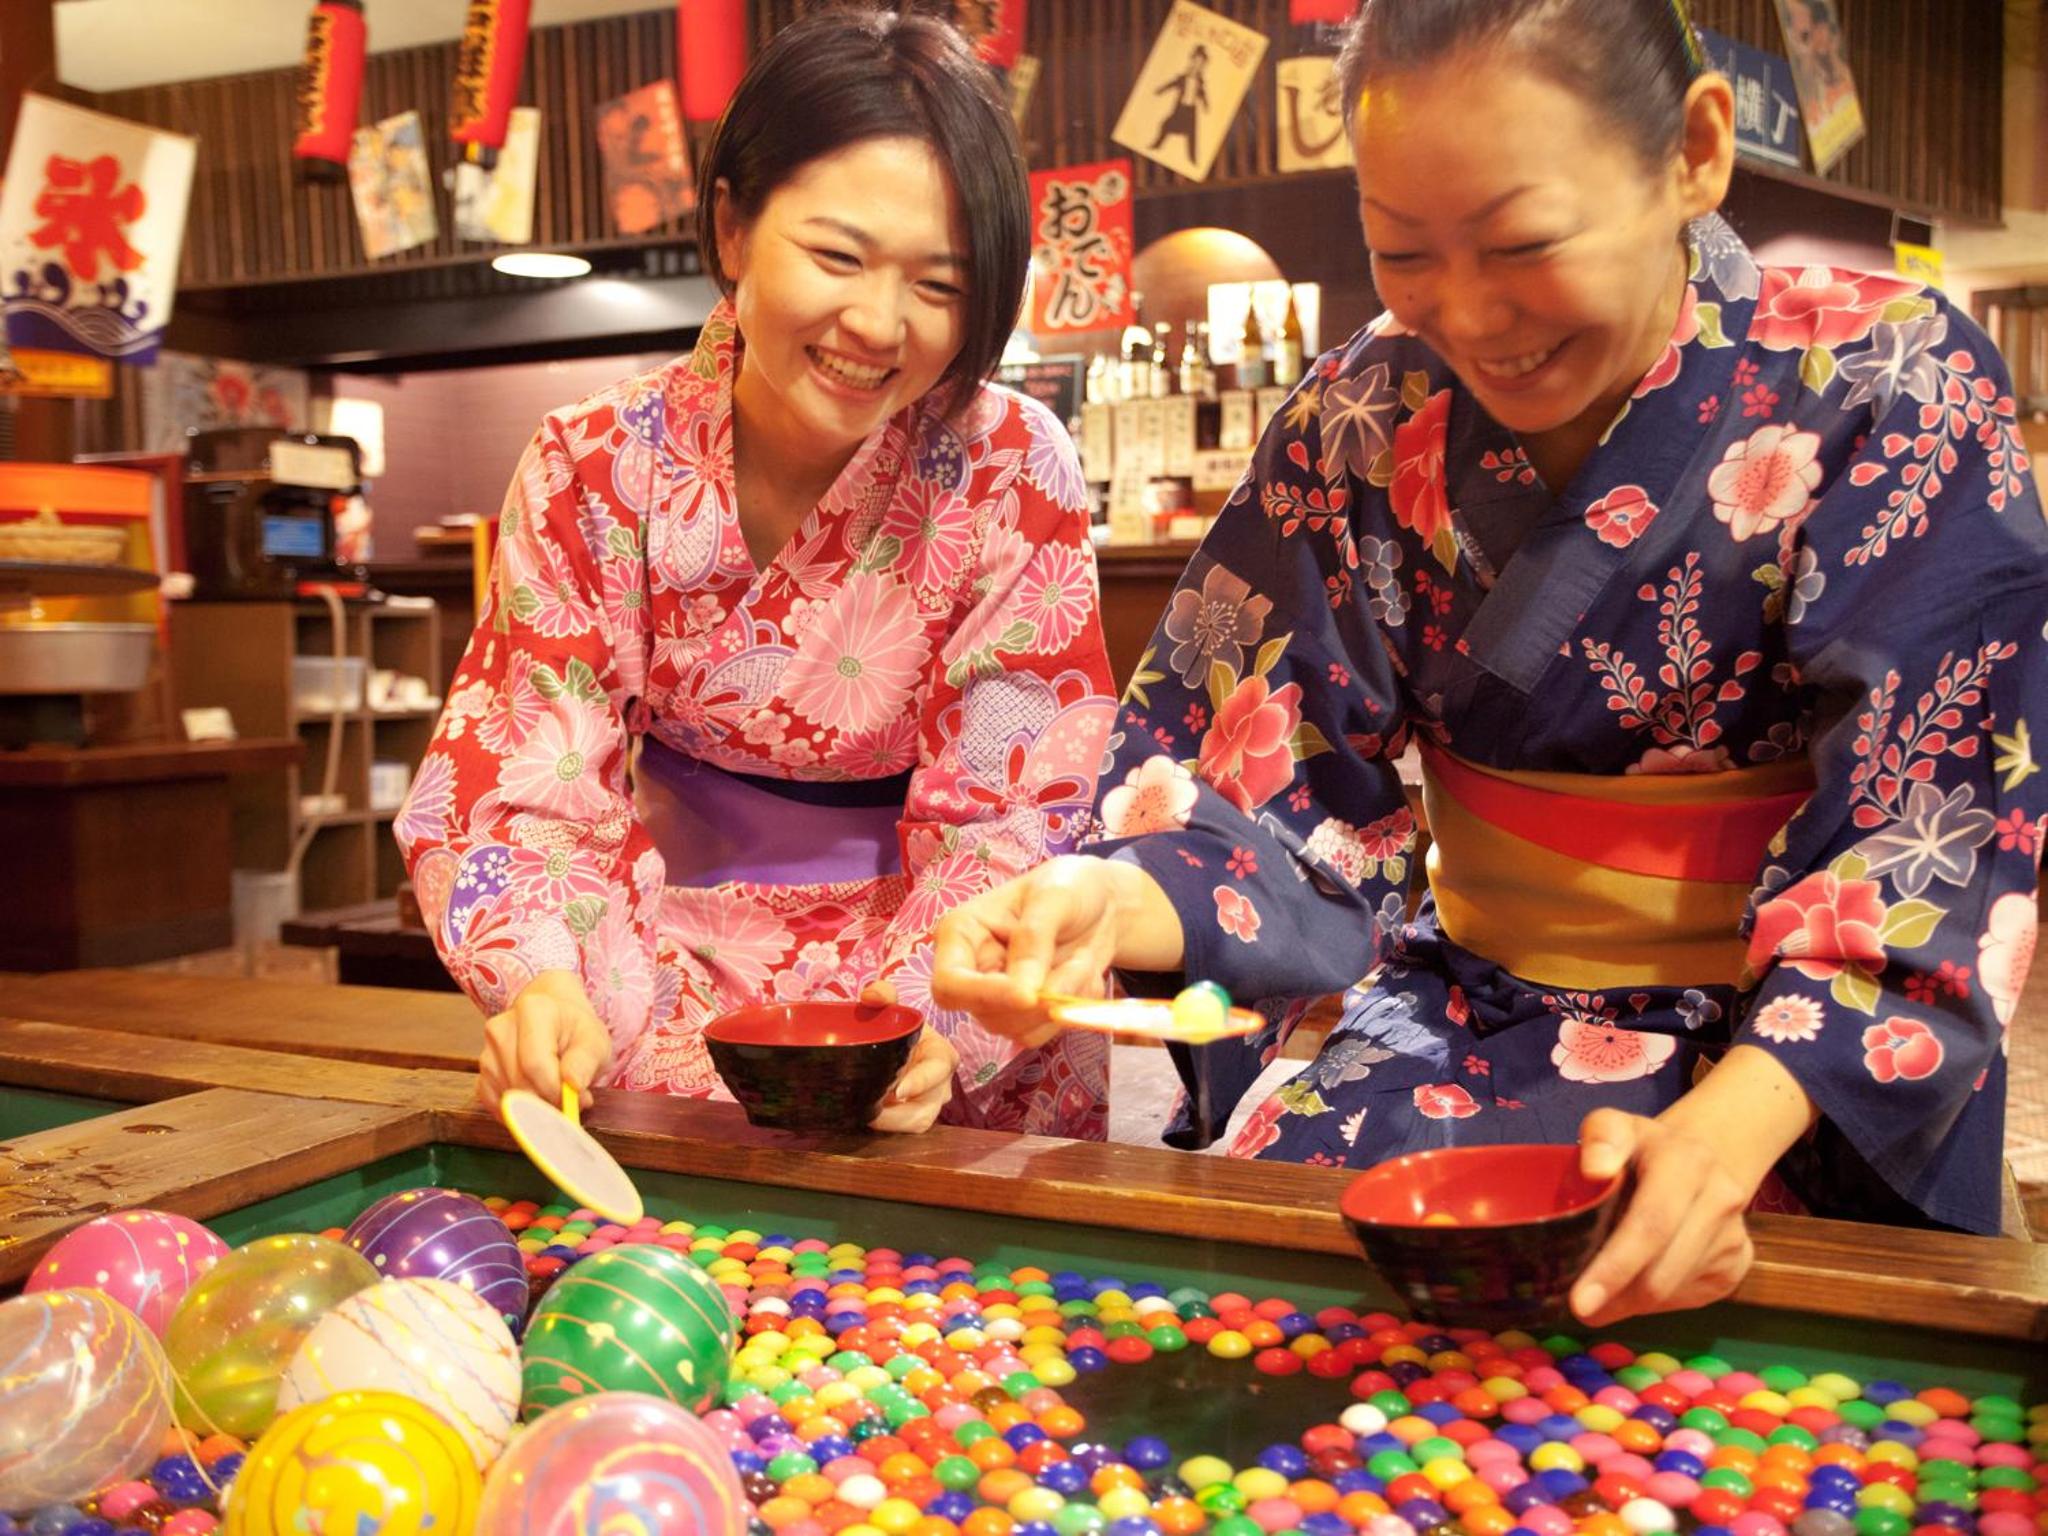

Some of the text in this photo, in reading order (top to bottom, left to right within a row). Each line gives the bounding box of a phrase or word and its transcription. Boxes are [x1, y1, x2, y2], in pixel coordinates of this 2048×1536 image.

[28, 153, 148, 282] 氷
[1045, 183, 1110, 324] おでん
